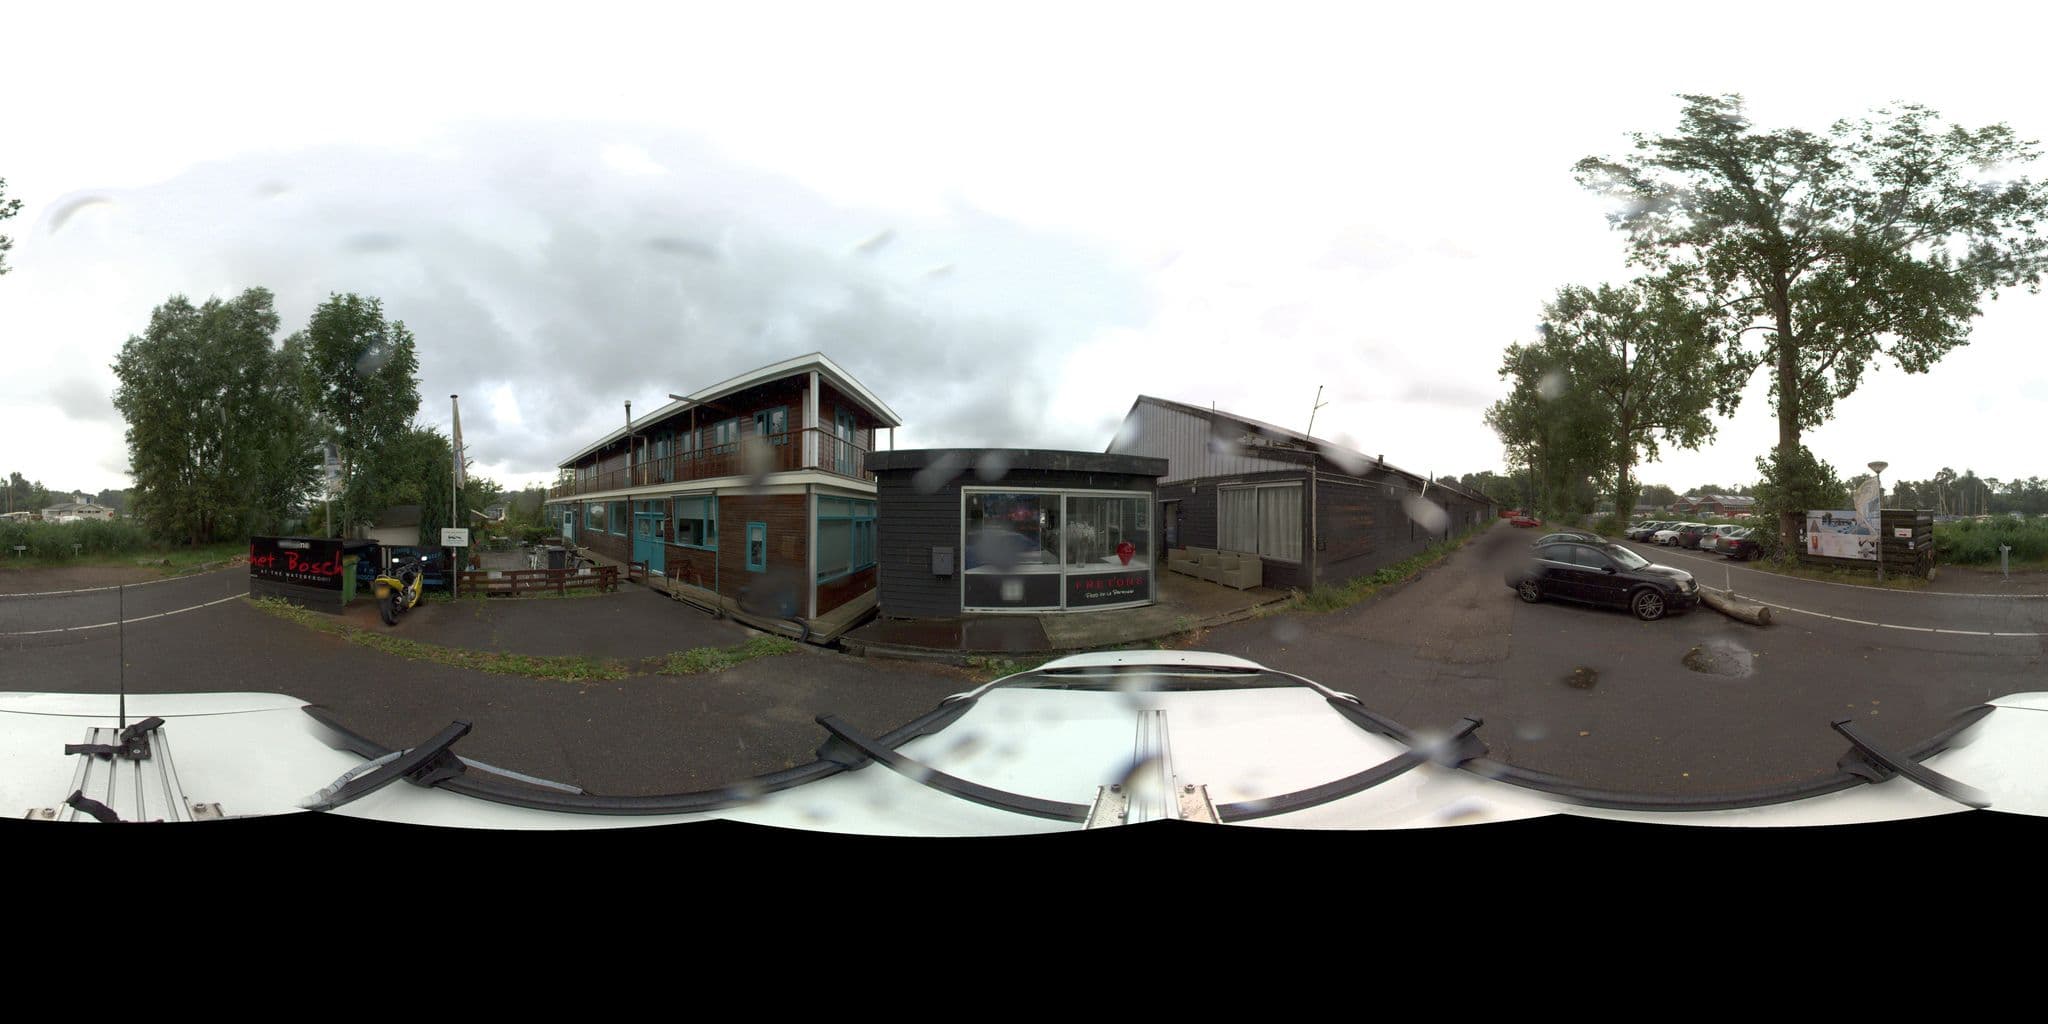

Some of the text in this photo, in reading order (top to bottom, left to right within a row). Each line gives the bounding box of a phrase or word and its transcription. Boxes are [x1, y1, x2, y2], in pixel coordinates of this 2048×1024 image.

[249, 543, 275, 568] het
[284, 550, 344, 576] Bosch
[285, 572, 331, 582] WATERFROT
